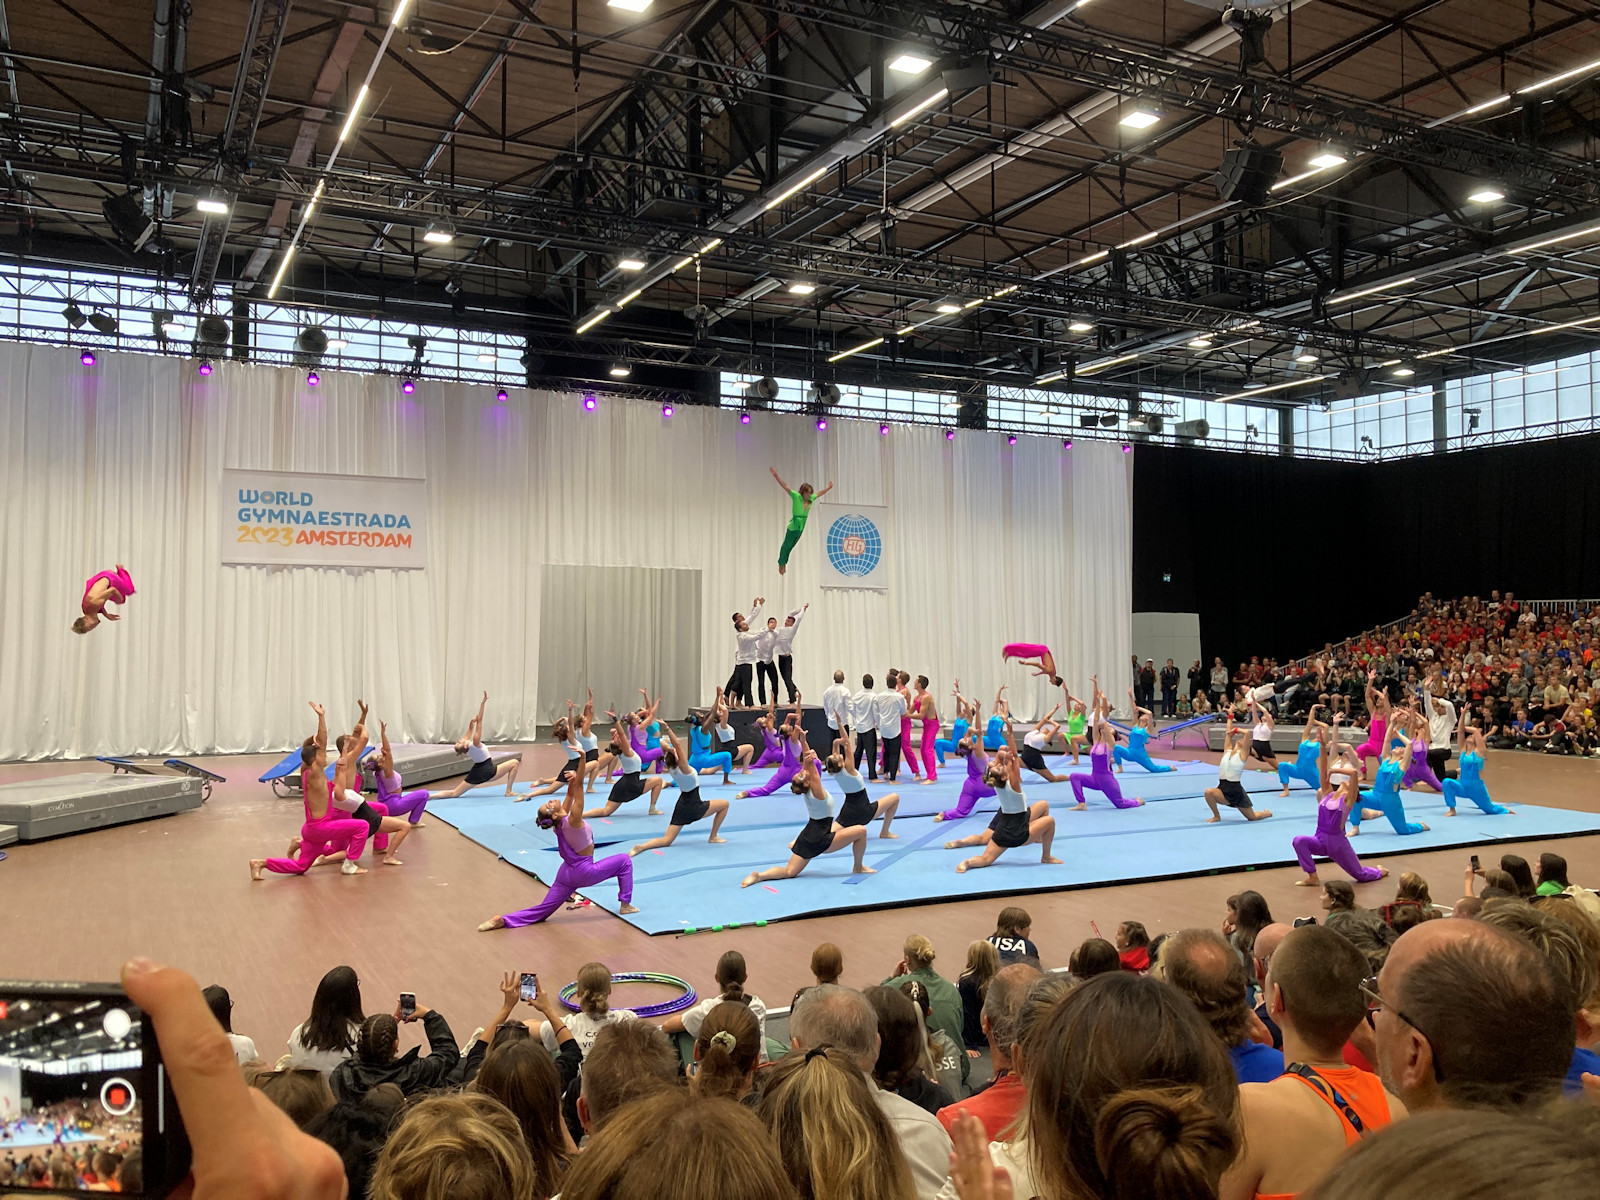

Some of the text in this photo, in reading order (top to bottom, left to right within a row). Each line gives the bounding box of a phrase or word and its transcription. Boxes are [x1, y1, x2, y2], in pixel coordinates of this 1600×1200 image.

[238, 489, 313, 507] WORLD
[237, 507, 411, 529] GYMNAESTRADA
[236, 525, 412, 549] 2023 AMSTERDAM
[988, 937, 1027, 955] USA
